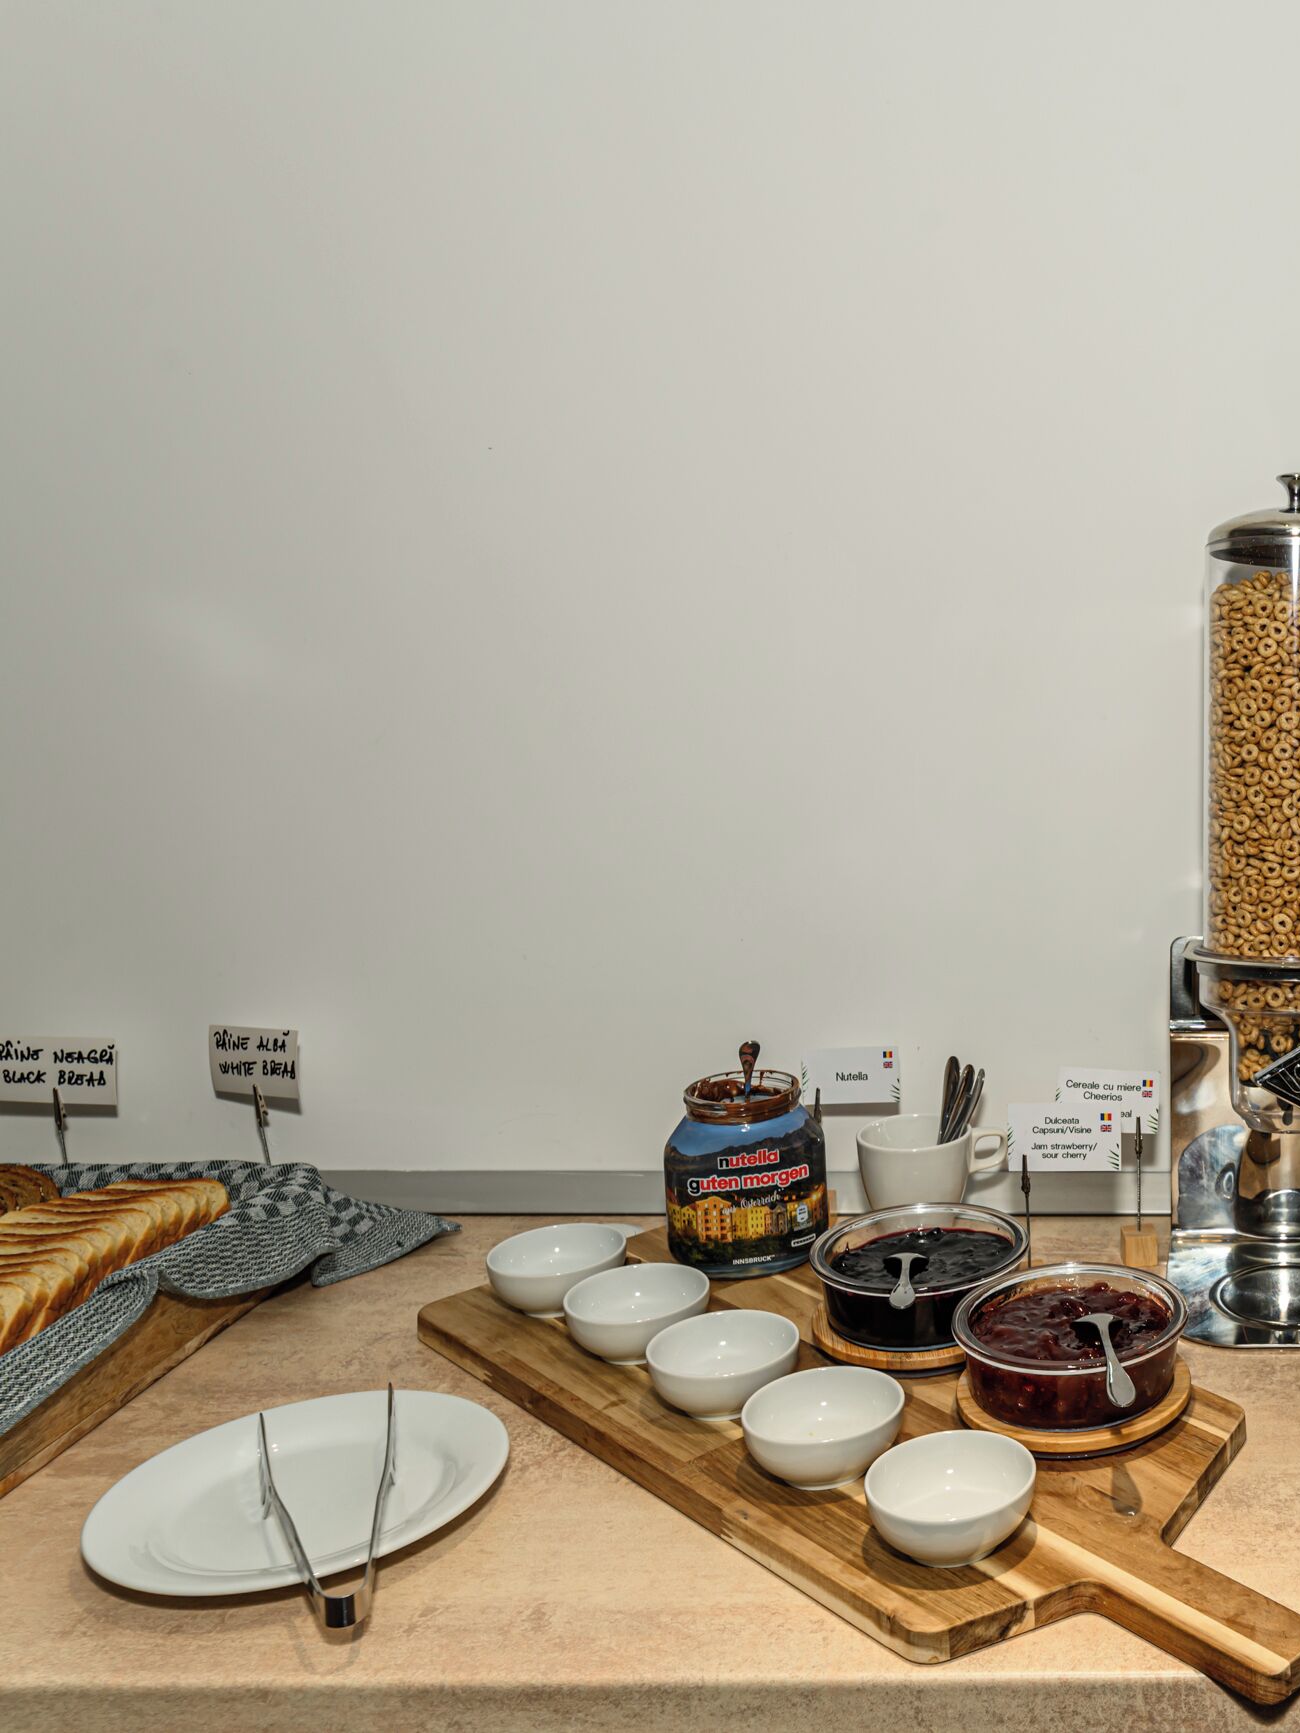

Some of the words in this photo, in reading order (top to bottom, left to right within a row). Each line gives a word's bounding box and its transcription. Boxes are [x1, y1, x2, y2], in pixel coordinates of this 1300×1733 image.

[256, 1030, 290, 1053] ALBĂ
[53, 1044, 115, 1066] NEAGRĂ
[219, 1060, 257, 1077] WHITE
[262, 1060, 296, 1080] BREAD
[835, 1071, 868, 1082] Nutella
[2, 1069, 46, 1084] BLACK
[58, 1069, 107, 1087] BREAD
[1065, 1079, 1100, 1090] Cereale
[1103, 1083, 1114, 1091] cu
[1116, 1081, 1142, 1092] miere
[1083, 1091, 1123, 1101] Cheerios
[1044, 1116, 1080, 1125] Dulceata
[1032, 1126, 1092, 1136] Capsuni/Visine
[1031, 1142, 1048, 1151] Jam
[1050, 1142, 1098, 1153] strawberry/
[717, 1149, 779, 1169] nutella
[1061, 1151, 1087, 1161] cherry
[687, 1173, 740, 1195] guten
[742, 1164, 809, 1189] morgen
